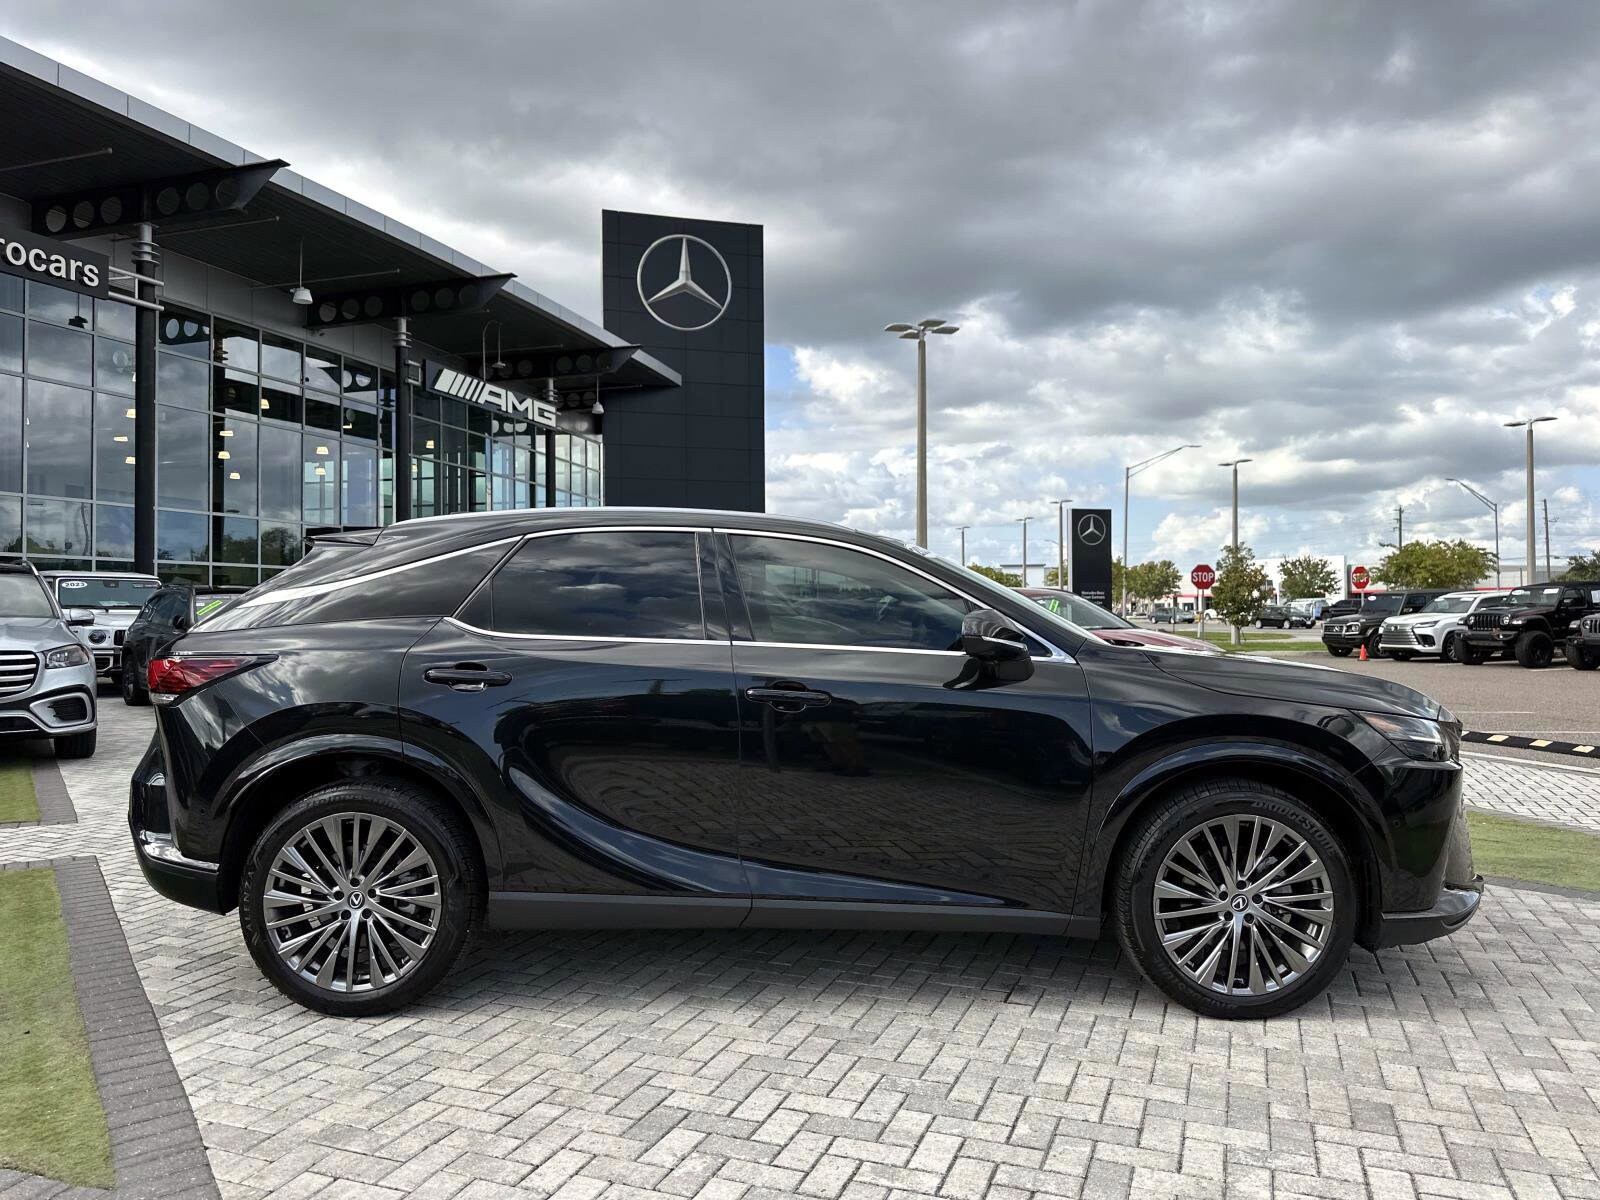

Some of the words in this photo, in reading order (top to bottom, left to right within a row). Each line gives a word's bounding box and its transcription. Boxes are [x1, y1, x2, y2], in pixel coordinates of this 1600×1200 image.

[478, 383, 557, 427] AMG
[1192, 572, 1214, 582] STOP
[1352, 572, 1368, 582] SP
[243, 871, 254, 932] ALENZA
